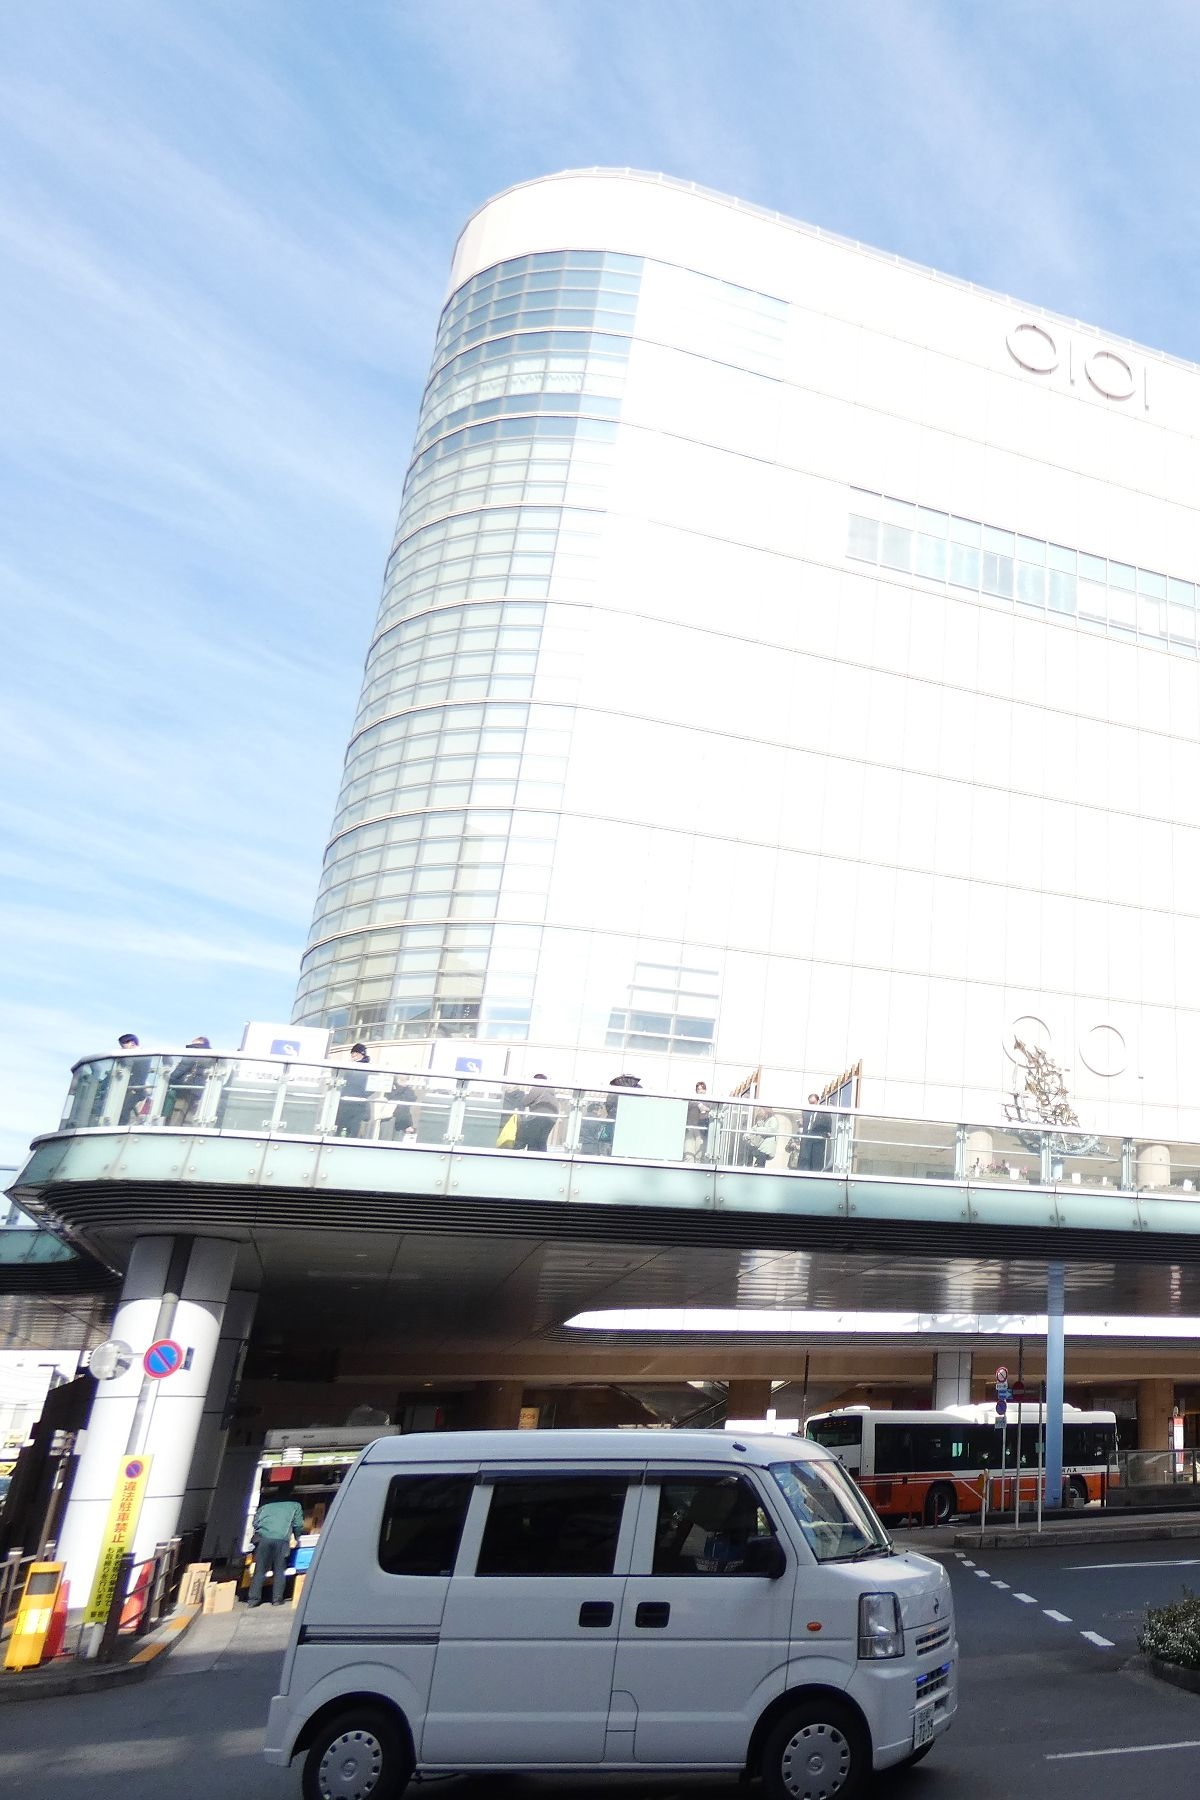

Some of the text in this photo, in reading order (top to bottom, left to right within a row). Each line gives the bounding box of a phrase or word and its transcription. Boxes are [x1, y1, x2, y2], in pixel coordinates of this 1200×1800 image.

[111, 1481, 137, 1544] 違法駐車禁止
